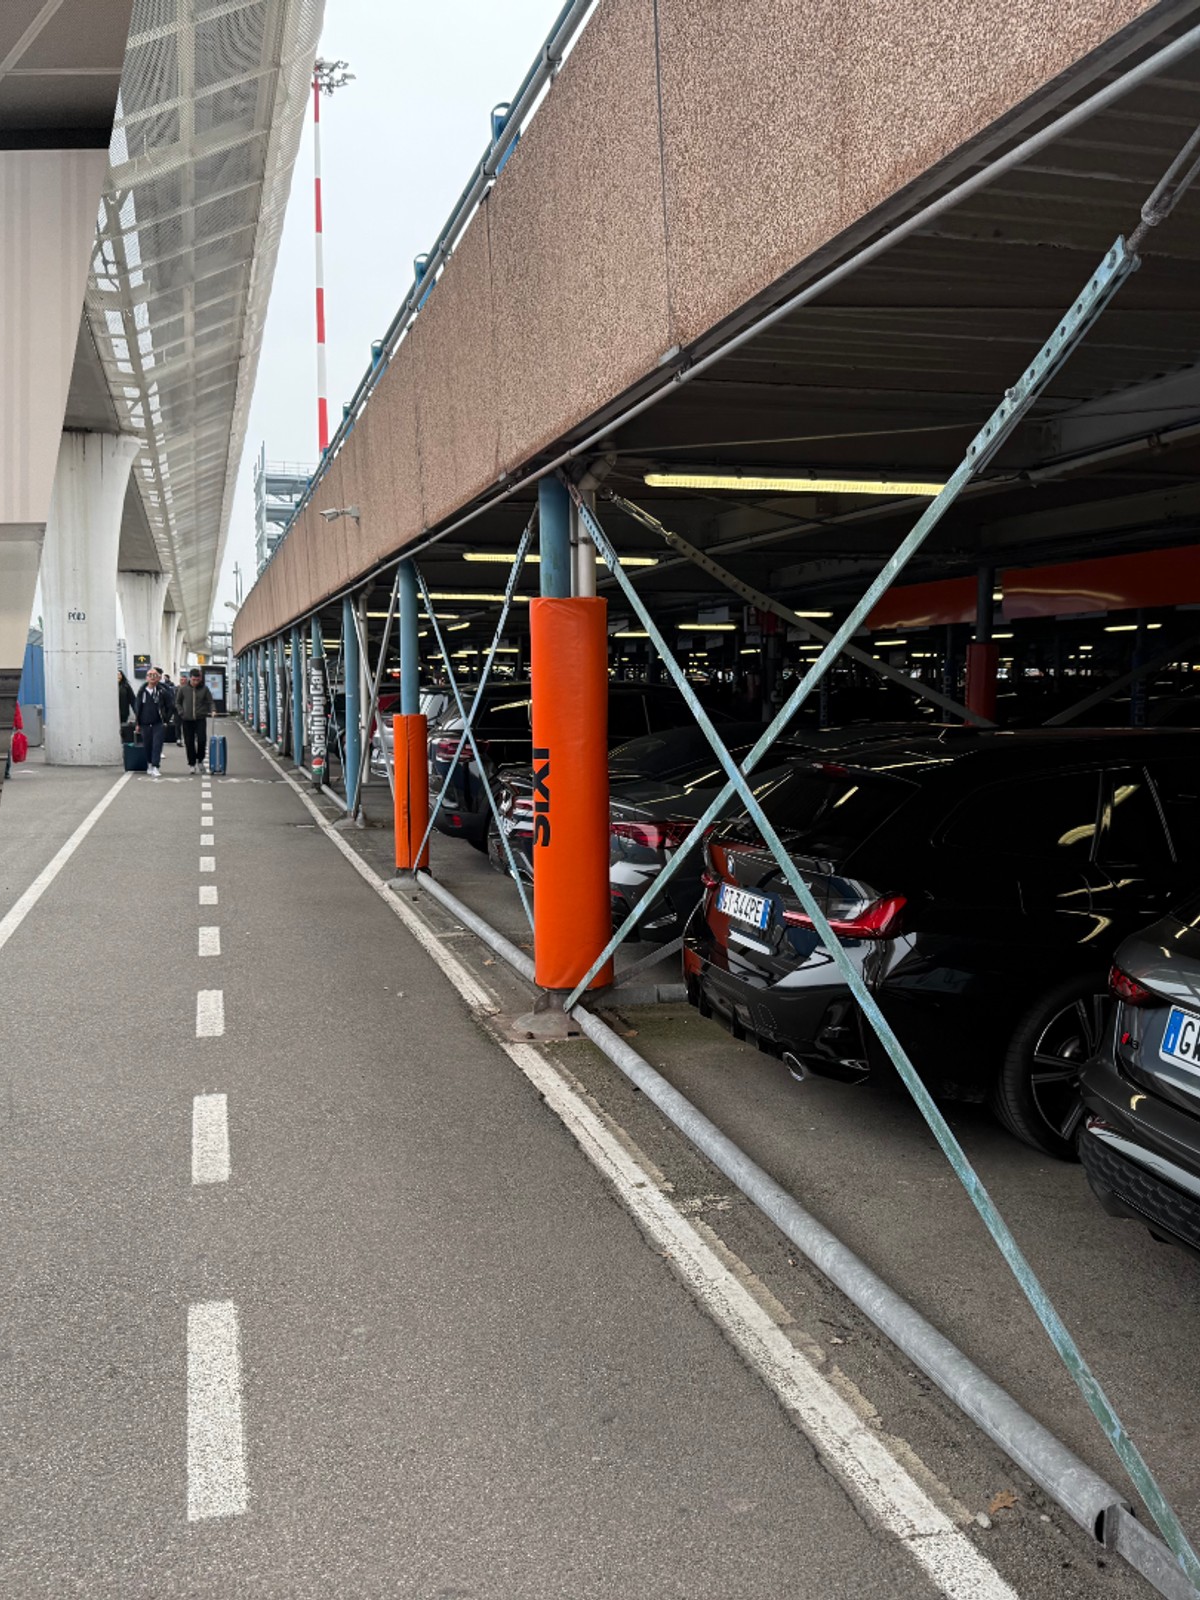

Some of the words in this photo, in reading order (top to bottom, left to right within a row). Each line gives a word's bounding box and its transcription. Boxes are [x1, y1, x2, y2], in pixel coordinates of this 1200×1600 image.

[310, 667, 324, 695] Car
[309, 697, 326, 715] by
[308, 716, 327, 756] Sicily
